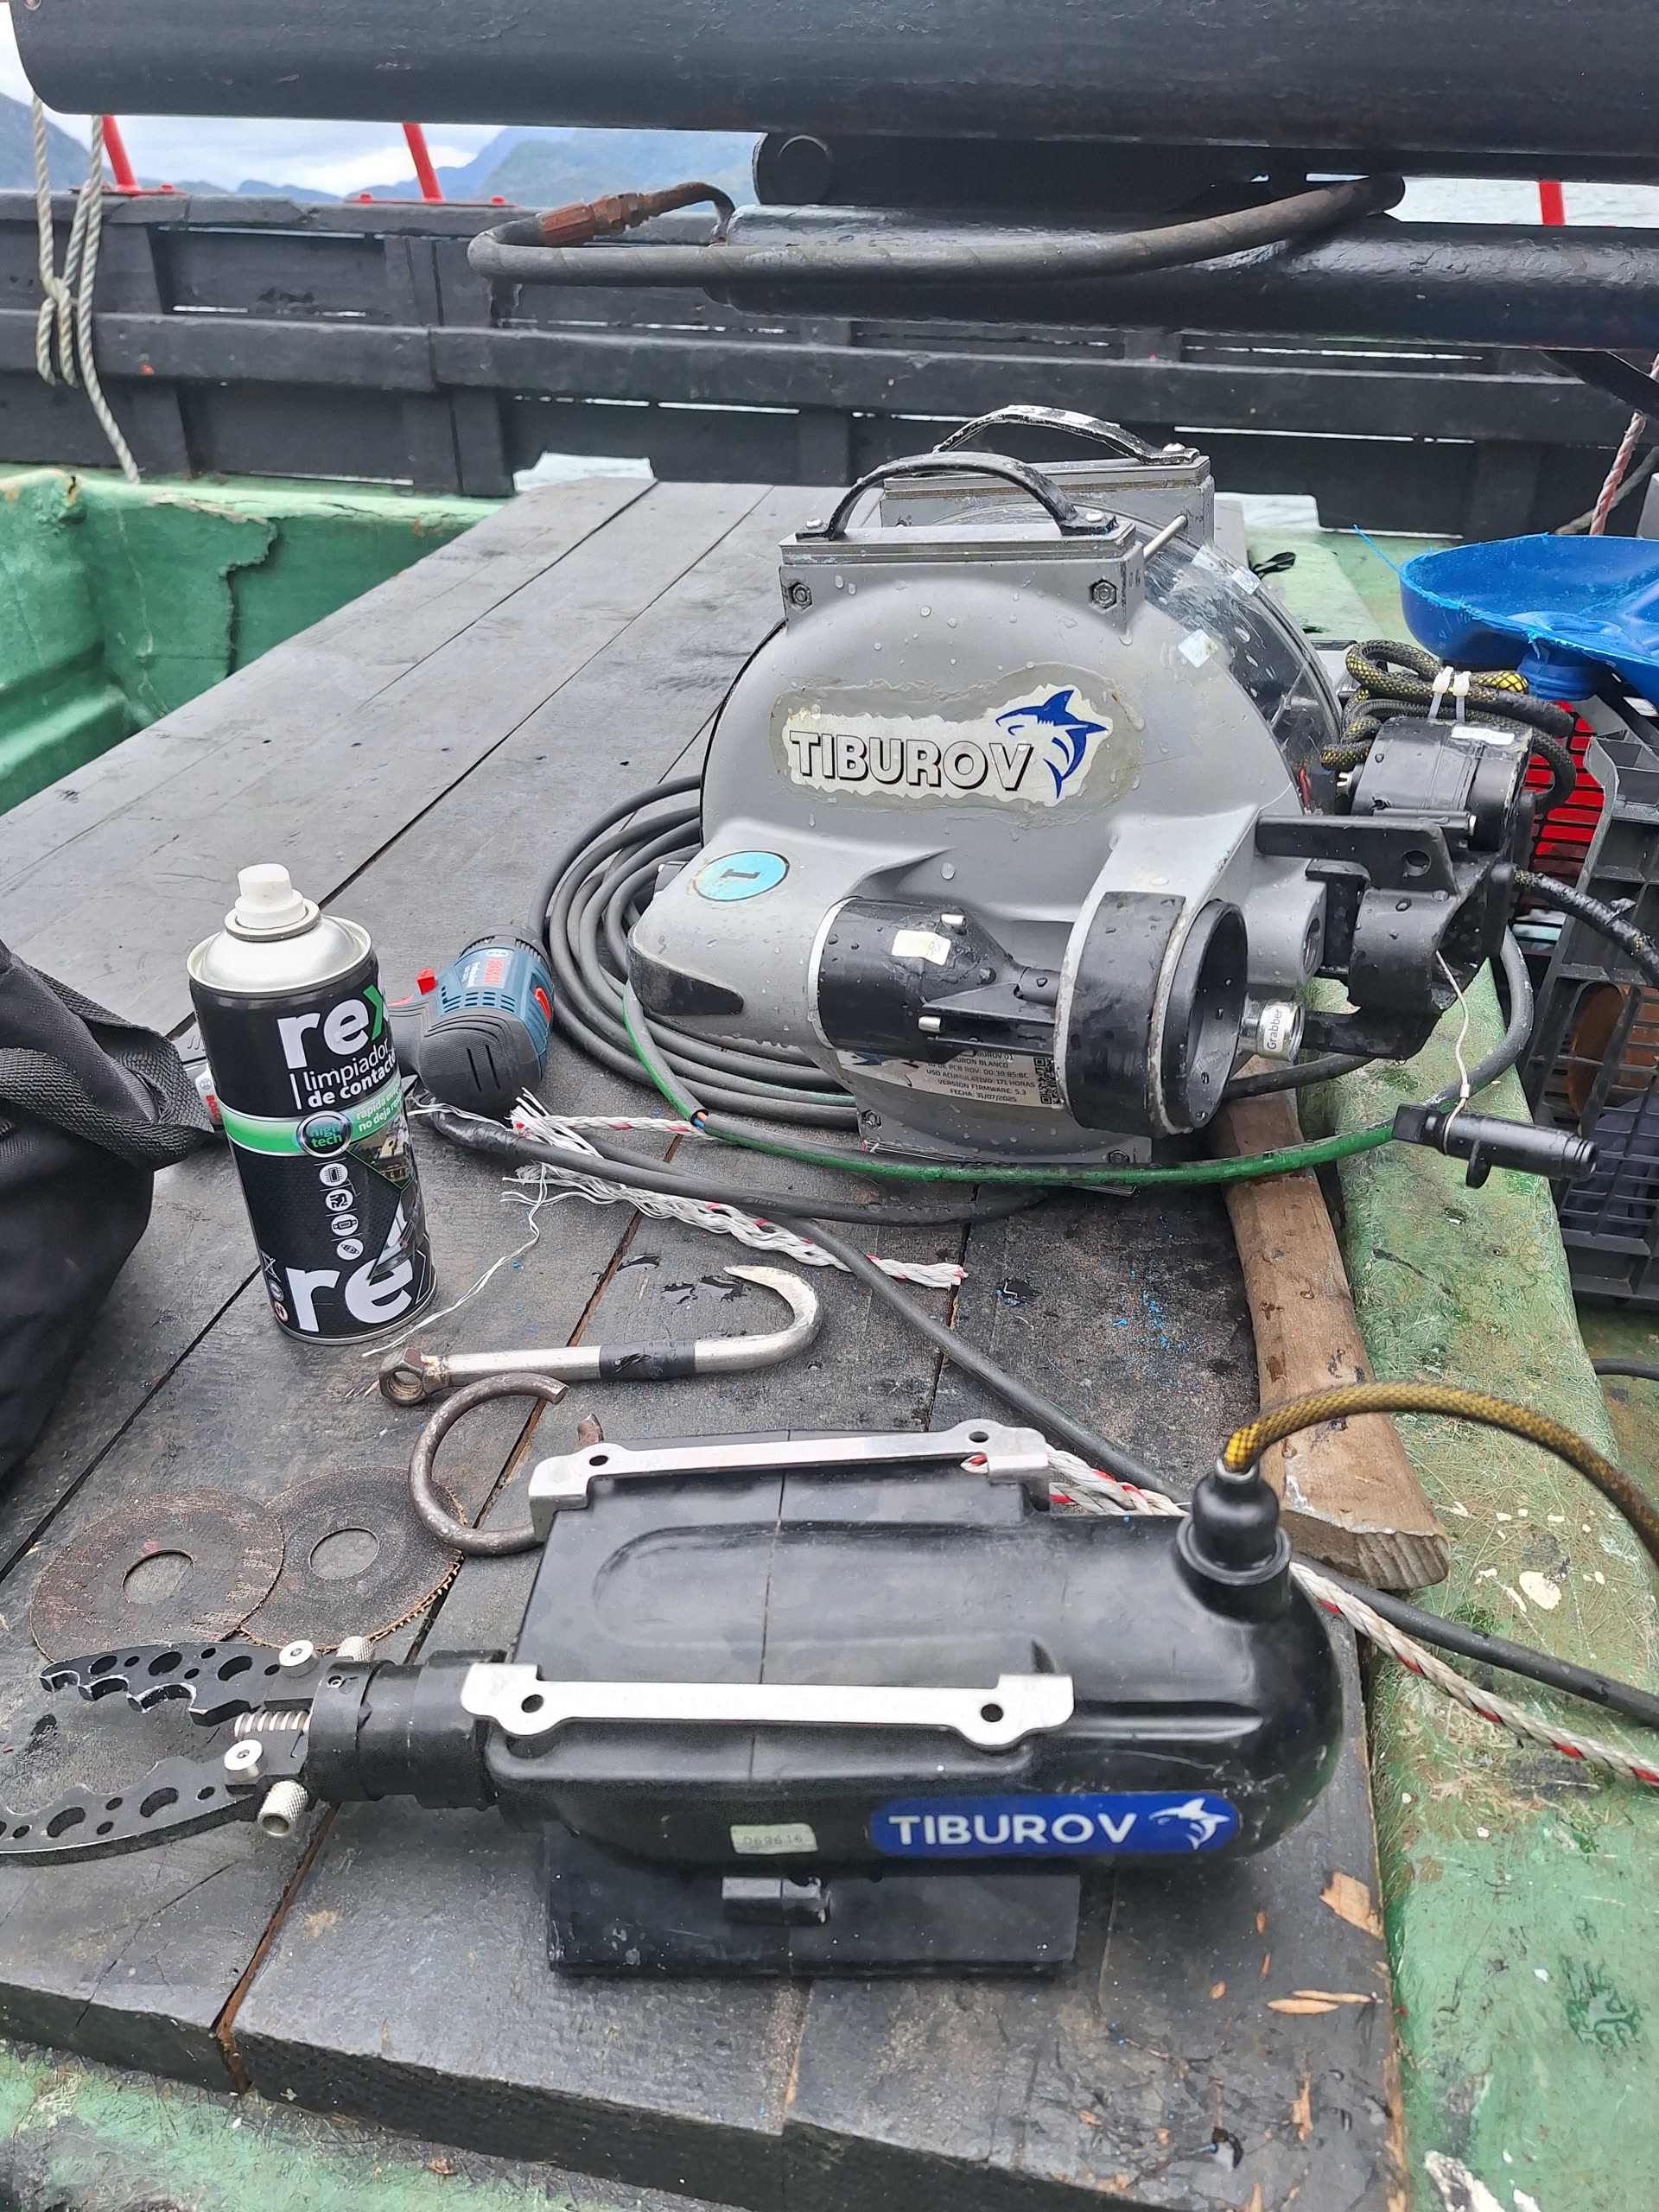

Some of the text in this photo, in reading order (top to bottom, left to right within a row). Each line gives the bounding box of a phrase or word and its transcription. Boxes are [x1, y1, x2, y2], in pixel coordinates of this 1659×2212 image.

[790, 730, 1034, 792] TIBUROV
[1267, 1008, 1283, 1050] Grabber
[303, 1038, 389, 1091] limpiador
[978, 1059, 1009, 1069] BLANCO
[308, 1090, 335, 1109] de
[950, 1088, 975, 1097] FECHA:
[206, 1094, 223, 1122] BOSC
[358, 1107, 391, 1132] no deja
[311, 1132, 343, 1148] tech
[887, 1811, 1138, 1847] TIBUROV
